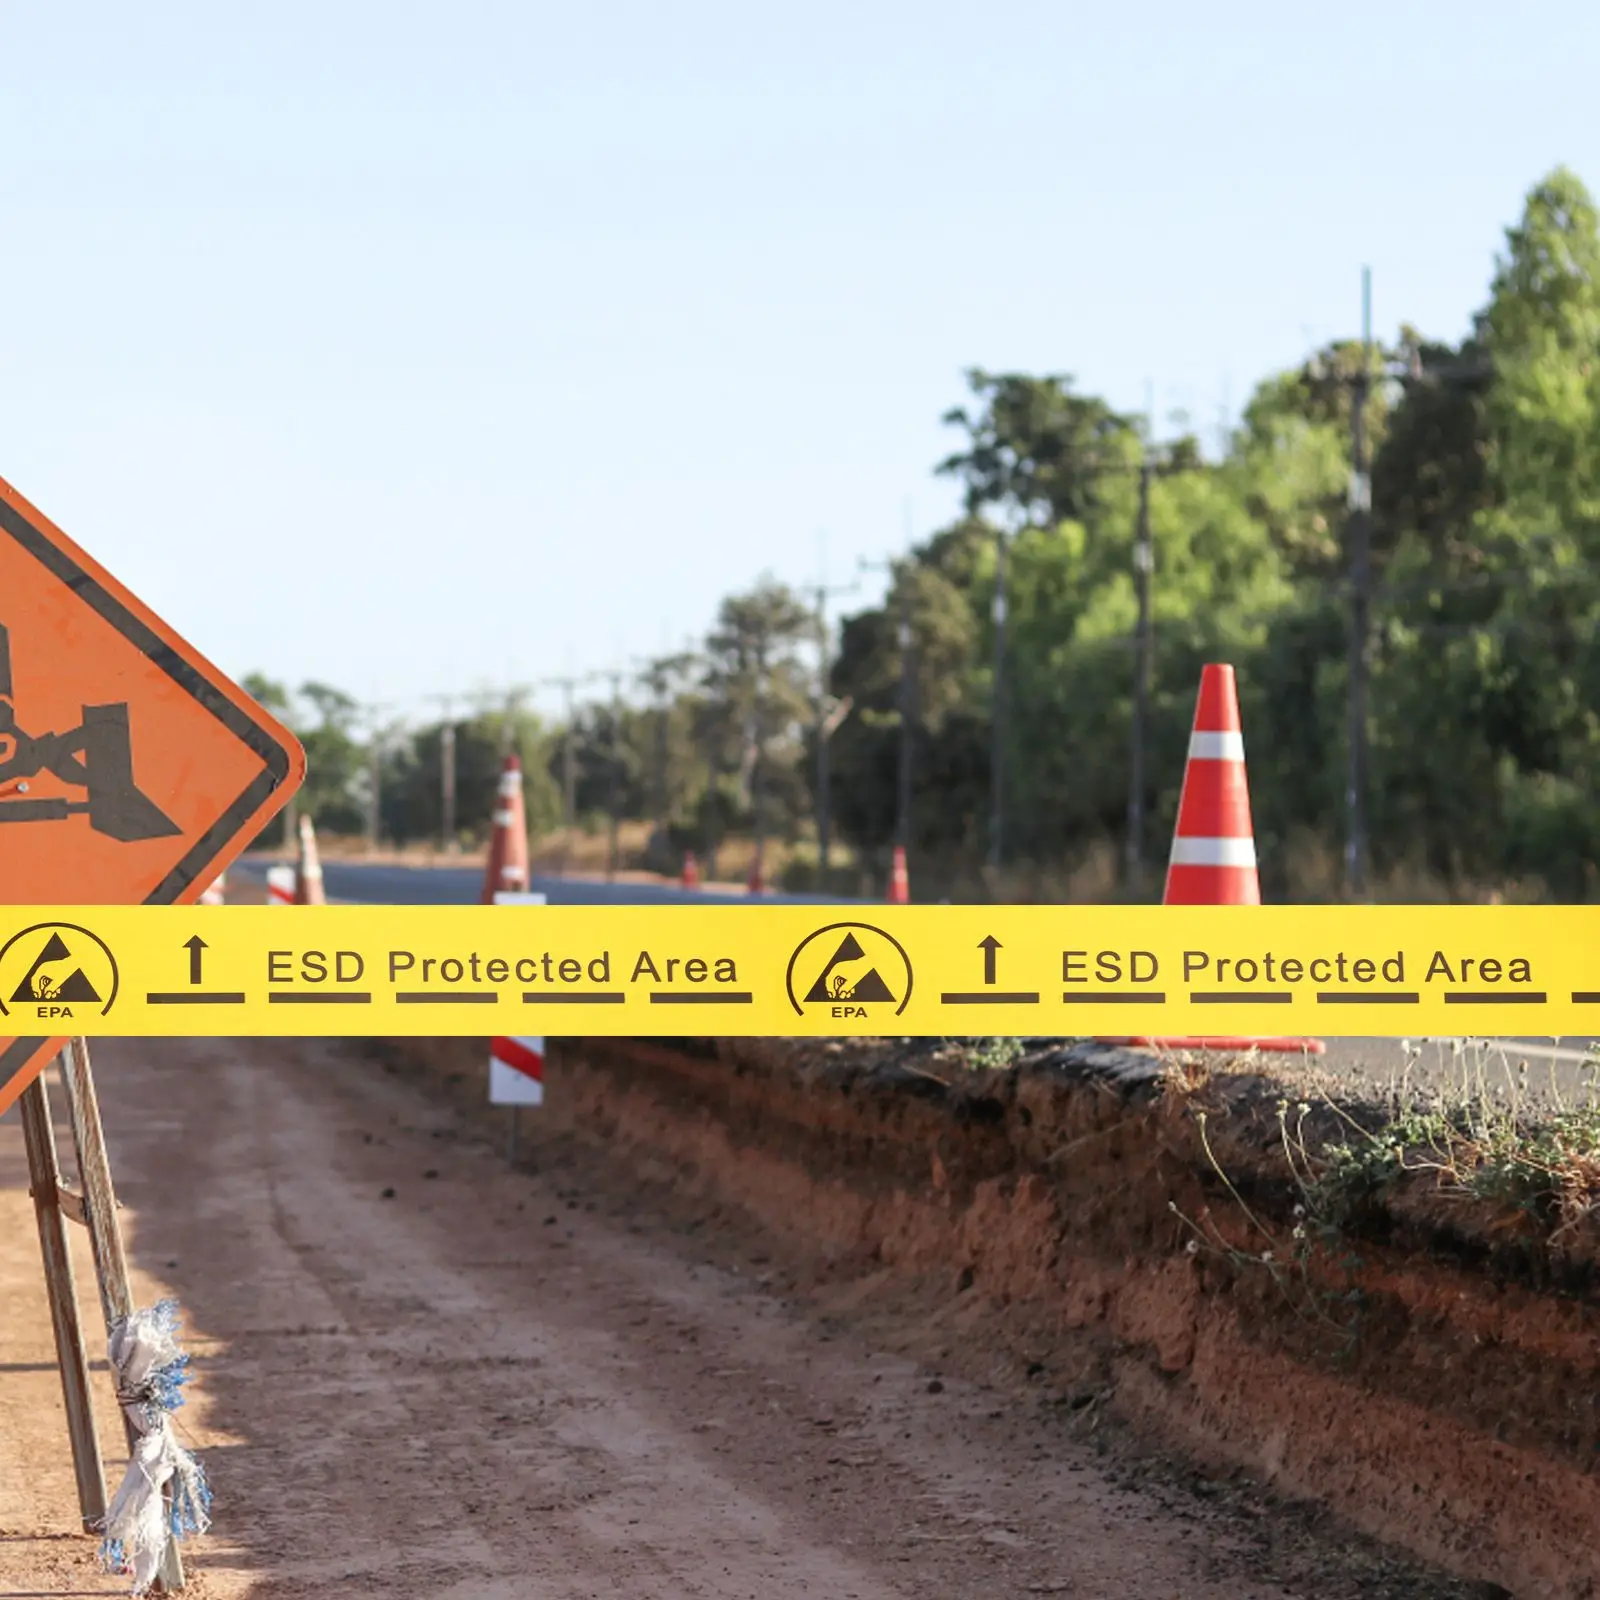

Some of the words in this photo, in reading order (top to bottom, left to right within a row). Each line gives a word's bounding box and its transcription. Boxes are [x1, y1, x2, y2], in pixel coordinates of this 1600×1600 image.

[268, 951, 364, 983] ESD
[389, 951, 610, 983] Protected
[630, 950, 737, 983] Area
[1062, 951, 1159, 983] ESD
[1183, 951, 1405, 983] Protected
[1424, 950, 1532, 983] Area
[37, 1006, 74, 1018] EPA
[831, 1006, 868, 1018] EPA
